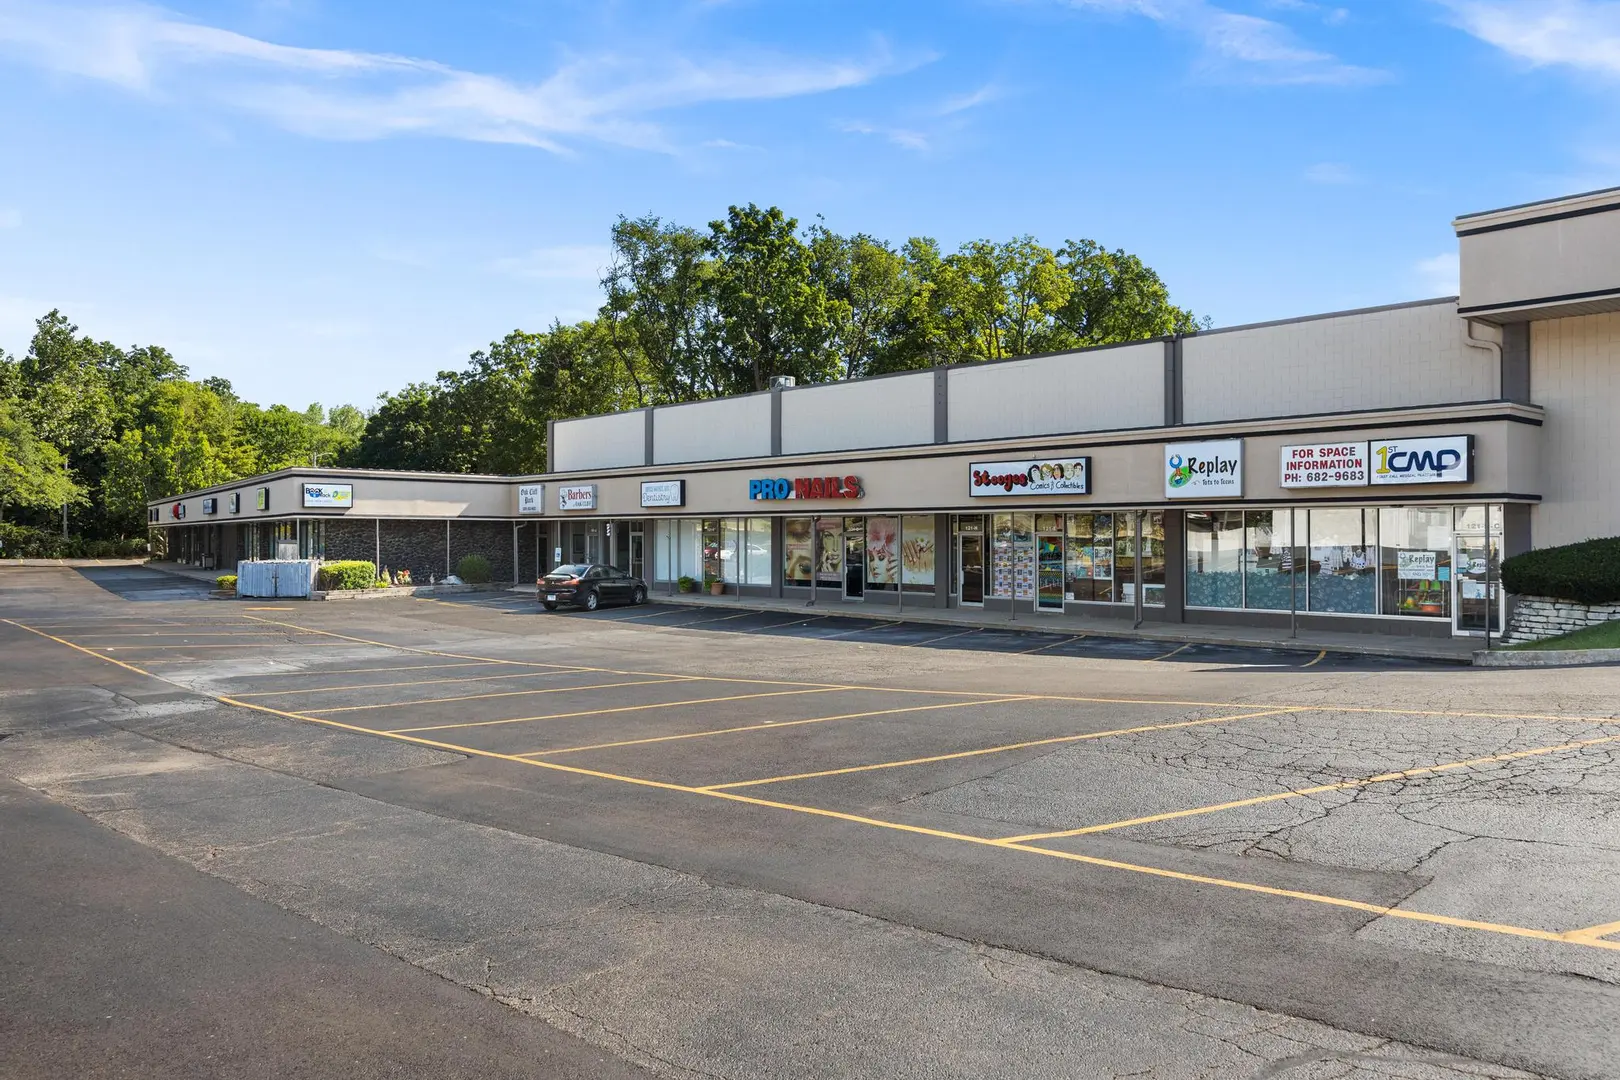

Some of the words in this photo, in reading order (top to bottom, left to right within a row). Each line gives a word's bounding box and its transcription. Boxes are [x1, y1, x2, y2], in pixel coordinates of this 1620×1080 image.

[1292, 449, 1314, 459] FOR
[1319, 446, 1356, 457] SPACE
[1187, 455, 1238, 477] Replay
[1286, 458, 1362, 471] INFORMATION
[1388, 449, 1461, 478] CMP
[973, 470, 1028, 492] Stooges
[1284, 473, 1301, 482] PH:
[1306, 470, 1365, 482] 682-9683
[749, 478, 790, 500] PRO
[794, 475, 861, 499] NAILS
[1029, 481, 1050, 490] Comics
[1055, 479, 1084, 490] Collectibles
[567, 488, 592, 501] Barbers
[1408, 554, 1435, 564] Replay
